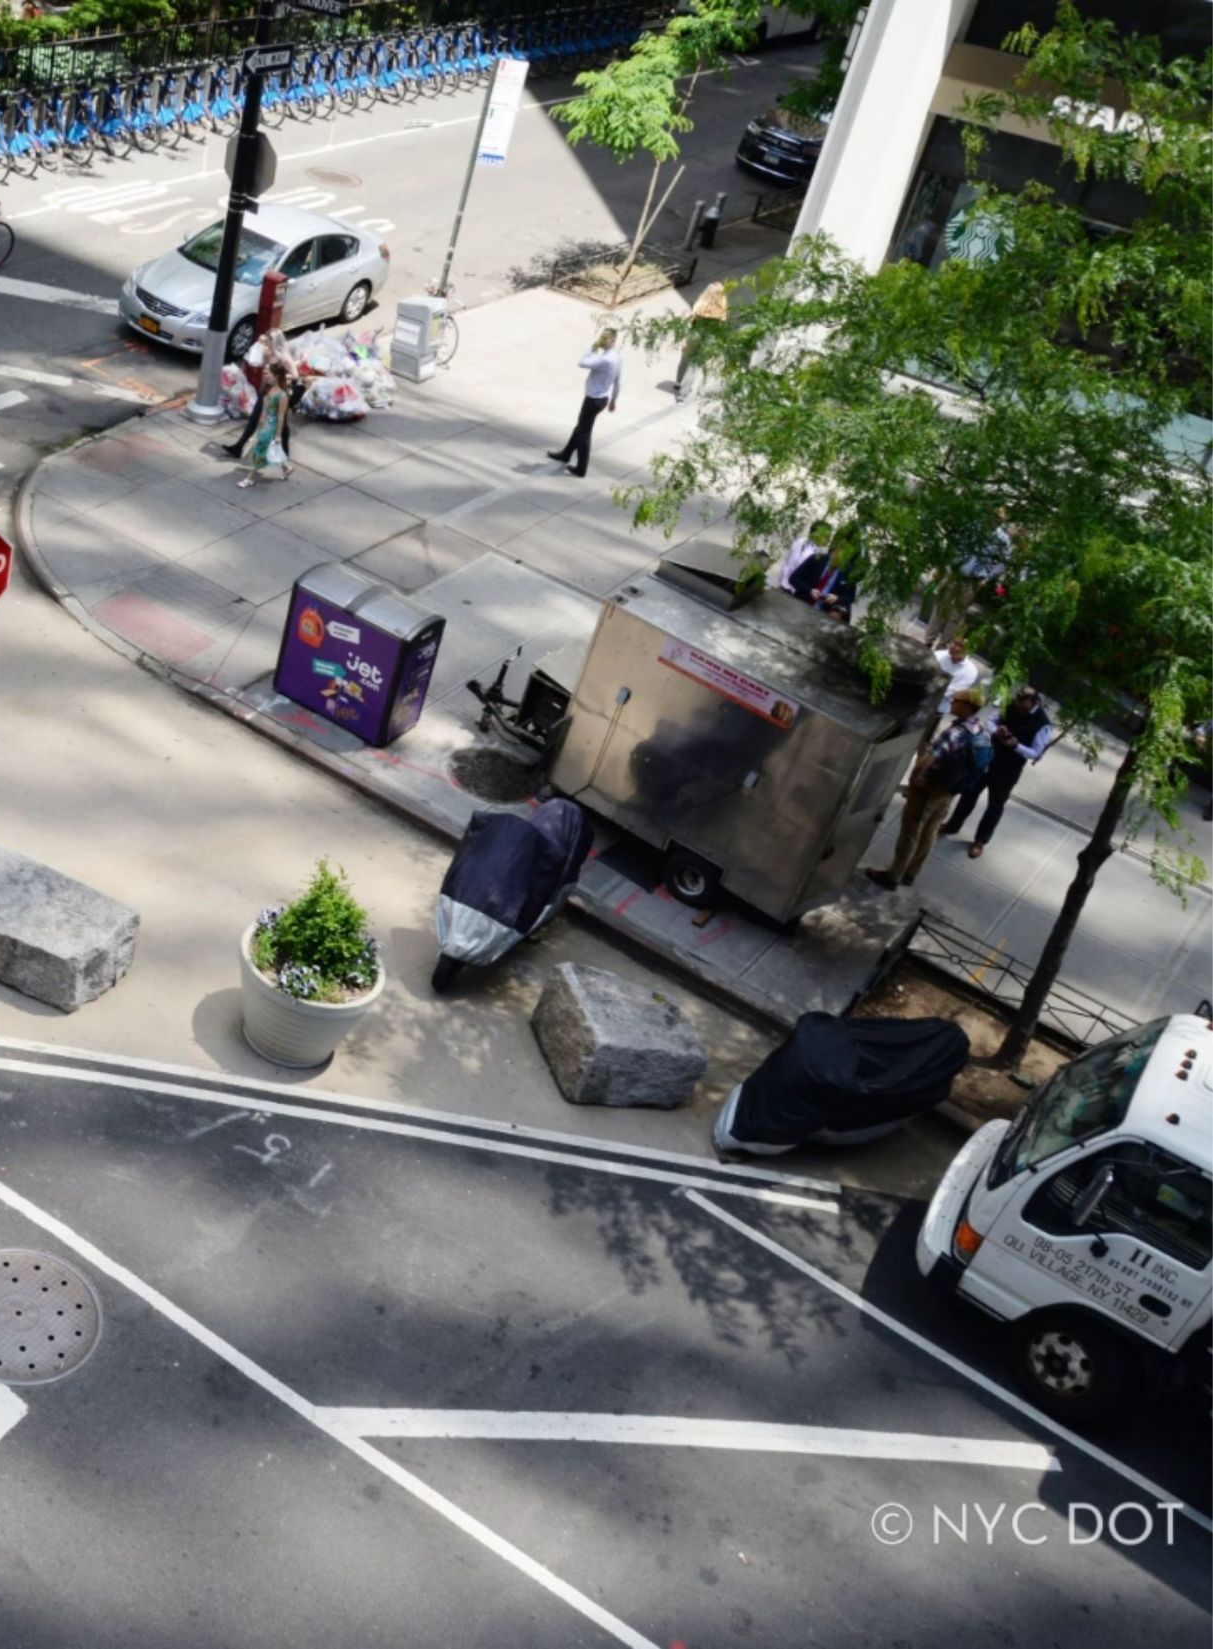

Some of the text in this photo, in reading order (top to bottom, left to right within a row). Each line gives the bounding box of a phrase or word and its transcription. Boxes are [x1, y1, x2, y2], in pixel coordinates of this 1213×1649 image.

[346, 651, 384, 685] jet
[1033, 1236, 1075, 1266] 98-05
[1074, 1260, 1111, 1286] 217th
[1112, 1297, 1151, 1325] 11429
